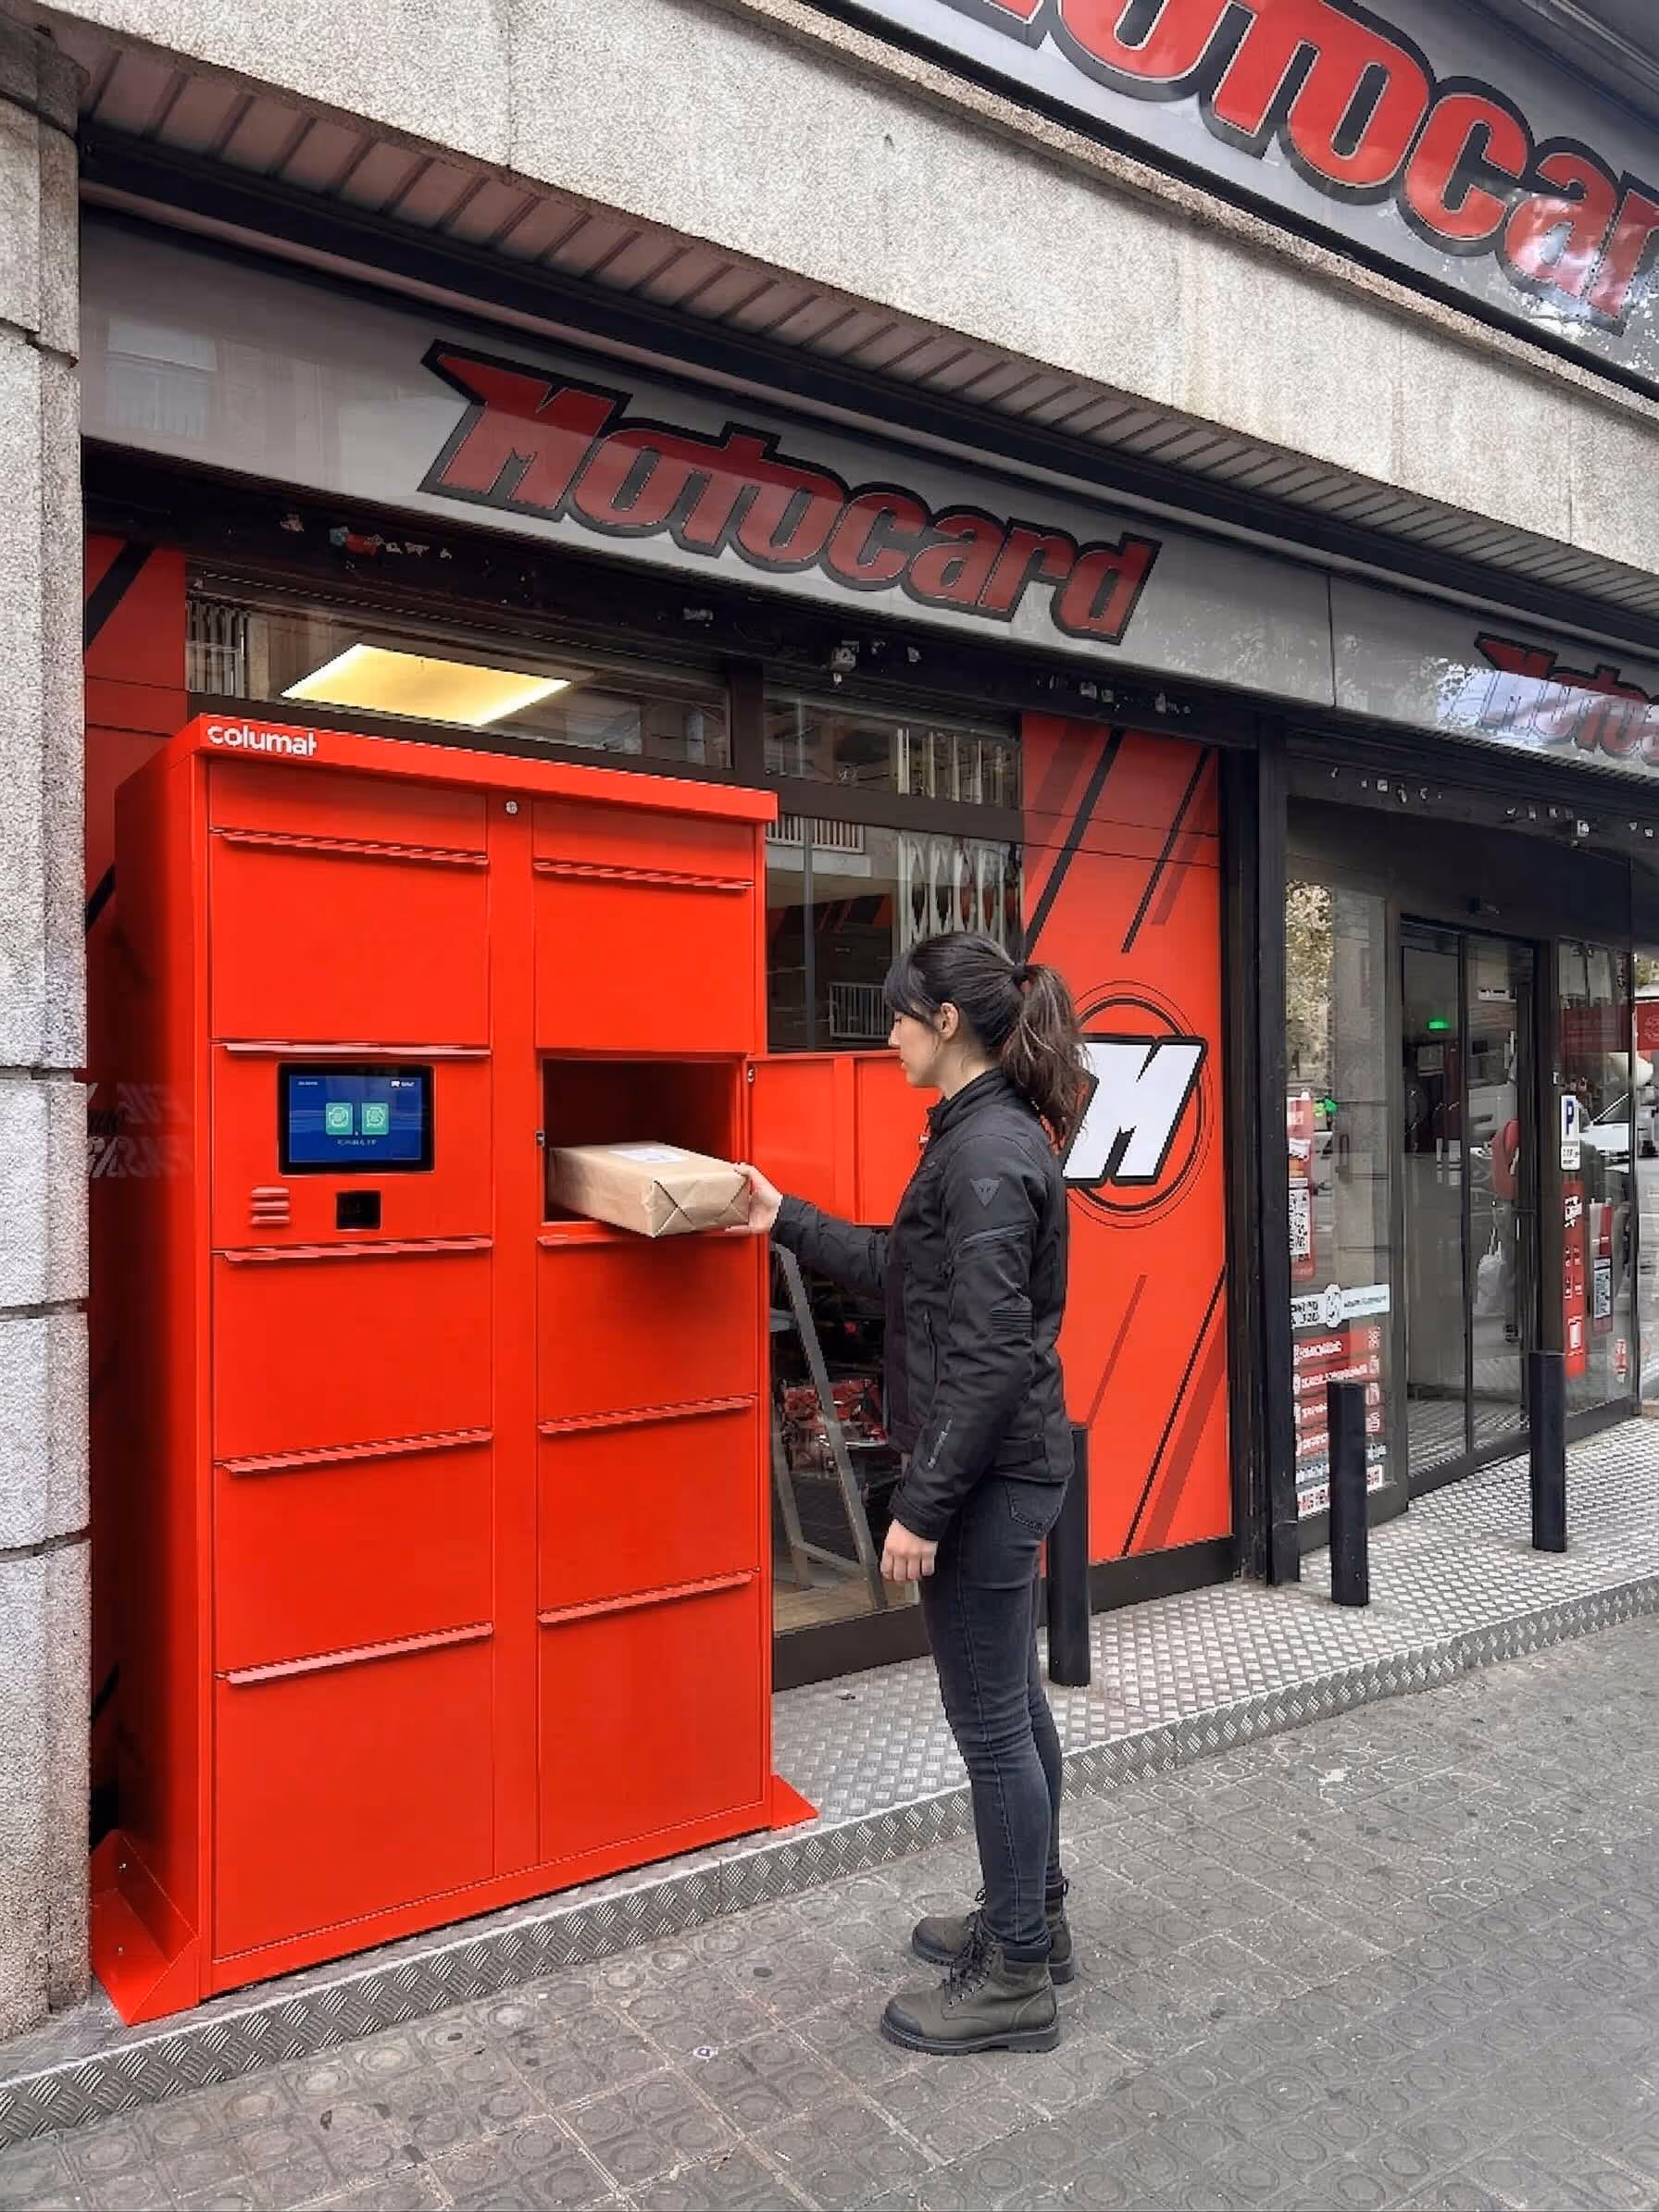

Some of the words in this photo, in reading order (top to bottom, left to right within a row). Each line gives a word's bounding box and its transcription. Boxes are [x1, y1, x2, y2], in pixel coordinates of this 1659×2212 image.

[937, 0, 1659, 337] otocar
[417, 339, 1163, 646] Motocard
[206, 725, 318, 757] columat
